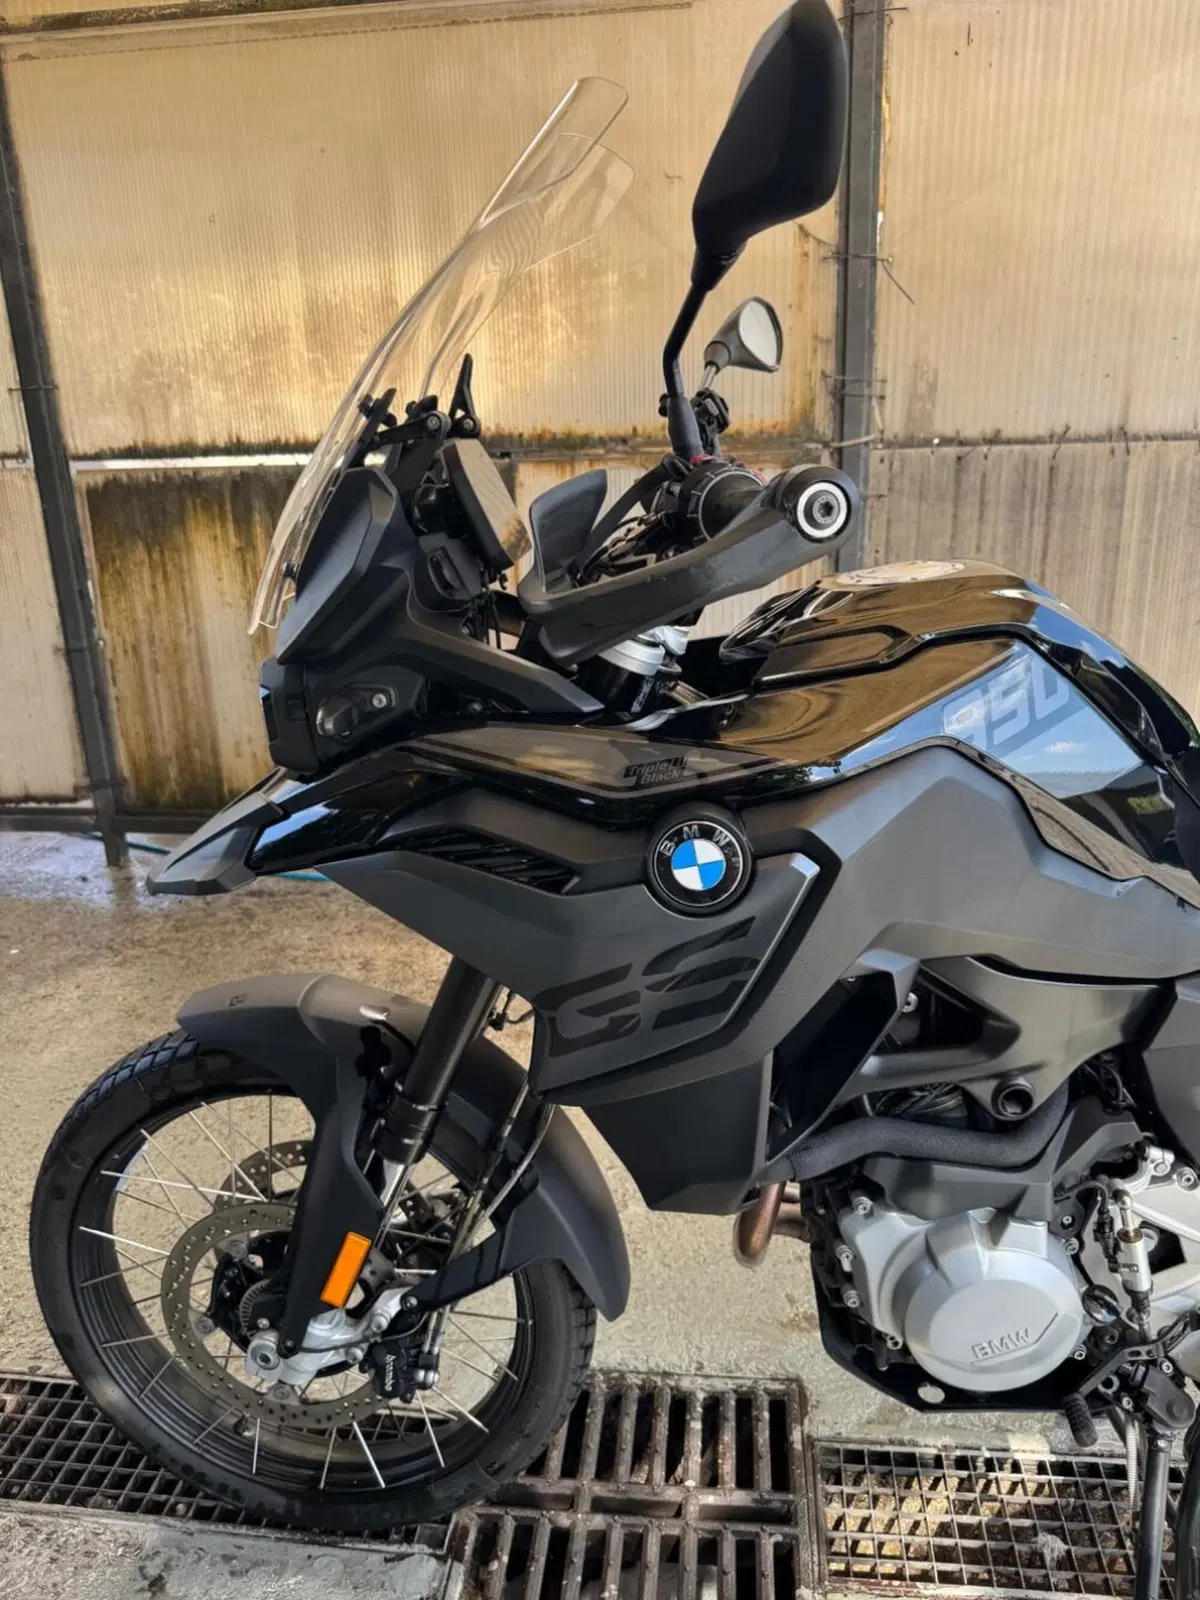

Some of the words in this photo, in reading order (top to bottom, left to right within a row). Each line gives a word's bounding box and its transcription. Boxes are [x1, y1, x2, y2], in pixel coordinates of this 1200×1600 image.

[660, 824, 731, 857] BMW
[533, 915, 761, 1057] GS
[971, 1327, 1031, 1359] BMW
[384, 1354, 396, 1391] brembo
